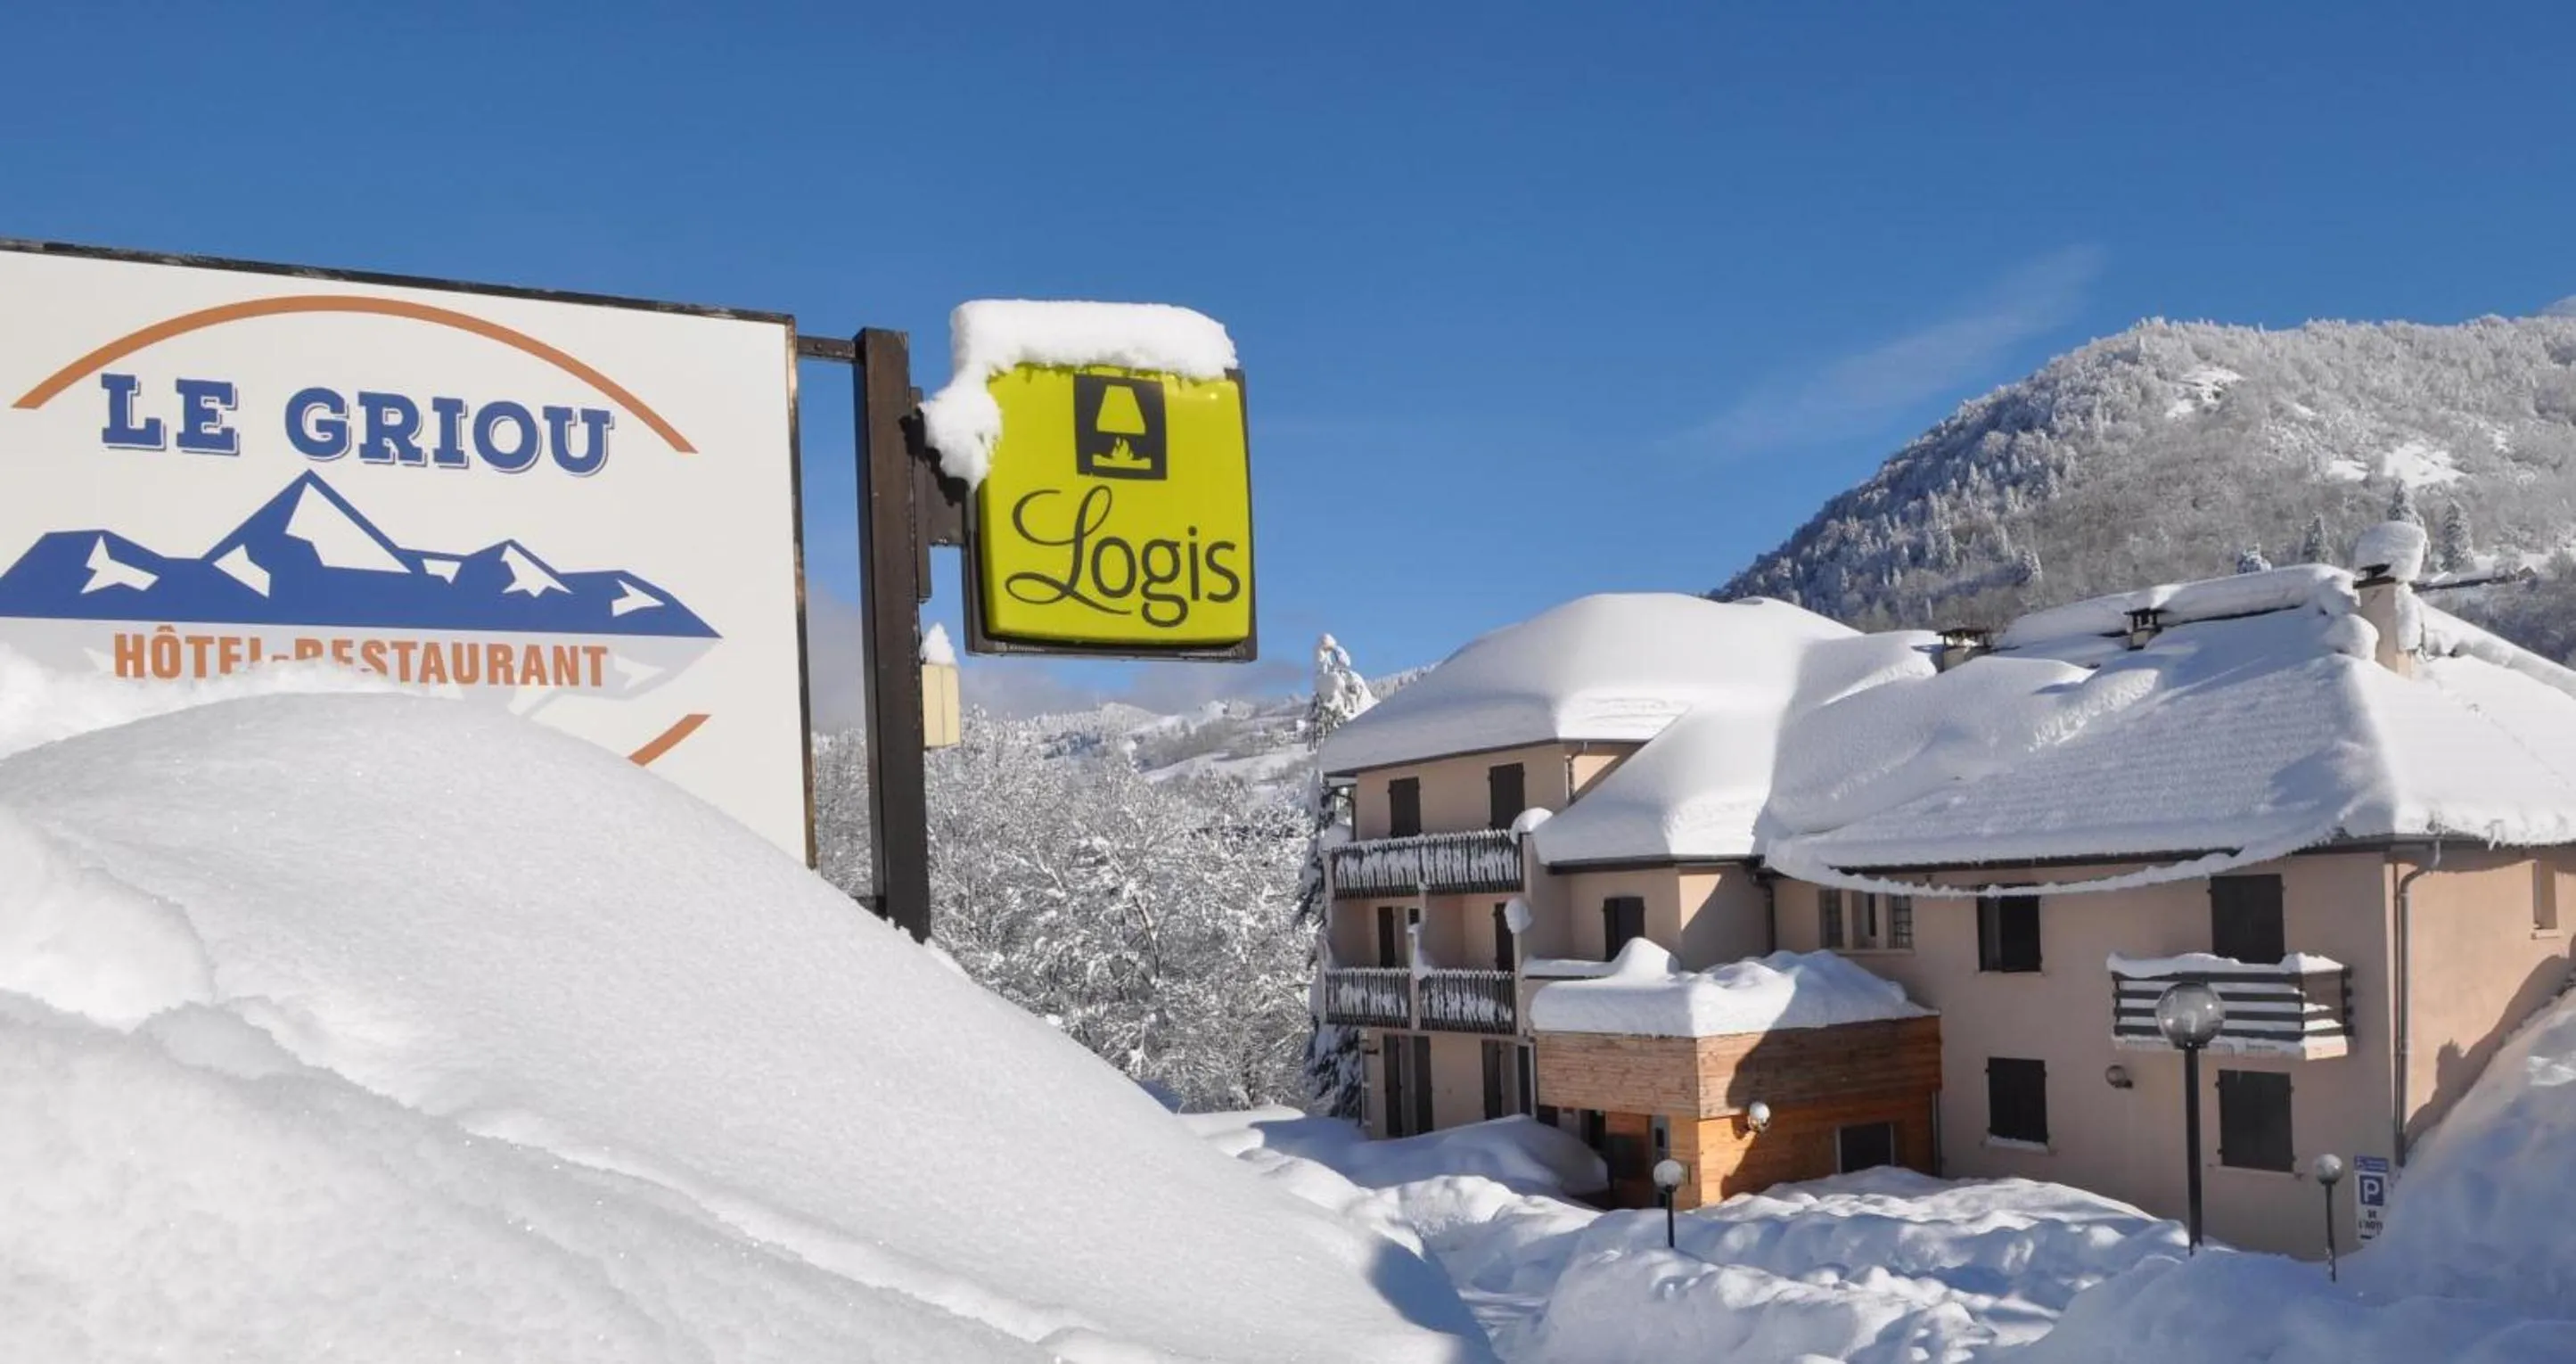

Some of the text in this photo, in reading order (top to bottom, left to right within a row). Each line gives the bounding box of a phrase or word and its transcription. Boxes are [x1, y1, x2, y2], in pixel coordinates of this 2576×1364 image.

[101, 373, 613, 475] LE GRIOU
[1005, 485, 1241, 628] Logis
[2363, 1179, 2380, 1202] P
